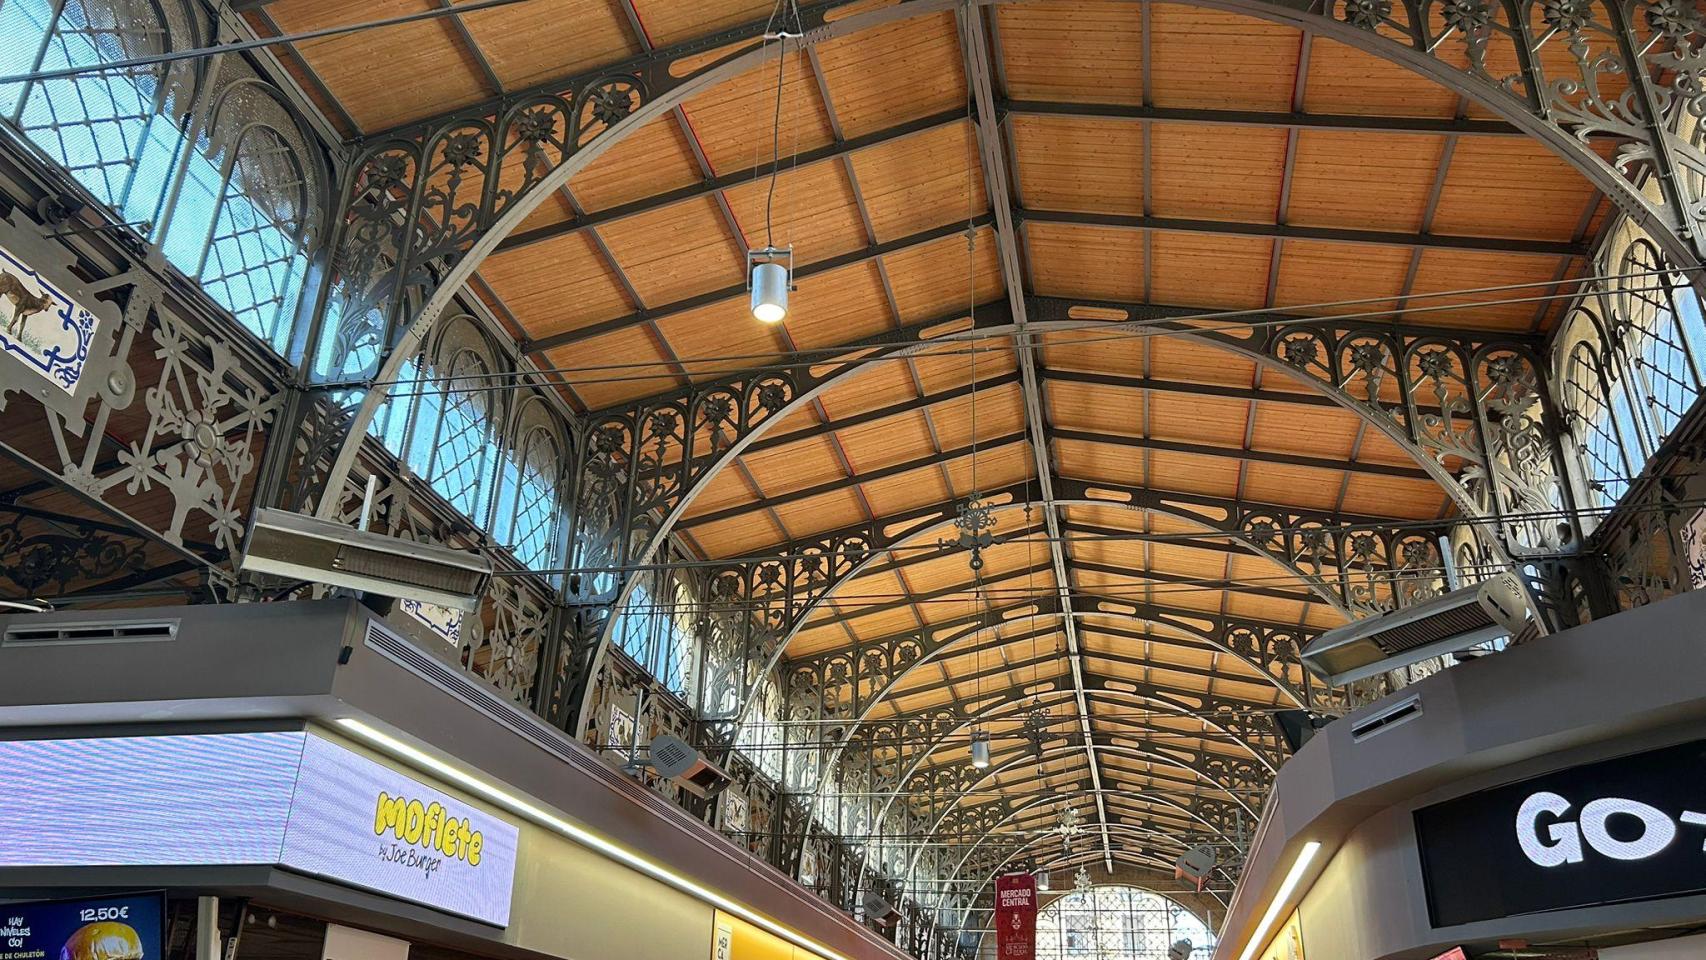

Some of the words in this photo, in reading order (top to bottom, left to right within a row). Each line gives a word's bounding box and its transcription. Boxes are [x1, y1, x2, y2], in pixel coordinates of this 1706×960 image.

[387, 844, 407, 865] Joe
[407, 848, 442, 879] Burger
[1000, 889, 1031, 899] MERCADO
[1002, 898, 1030, 907] CENTRAL
[80, 906, 129, 922] 12,50€
[8, 917, 24, 926] HAY
